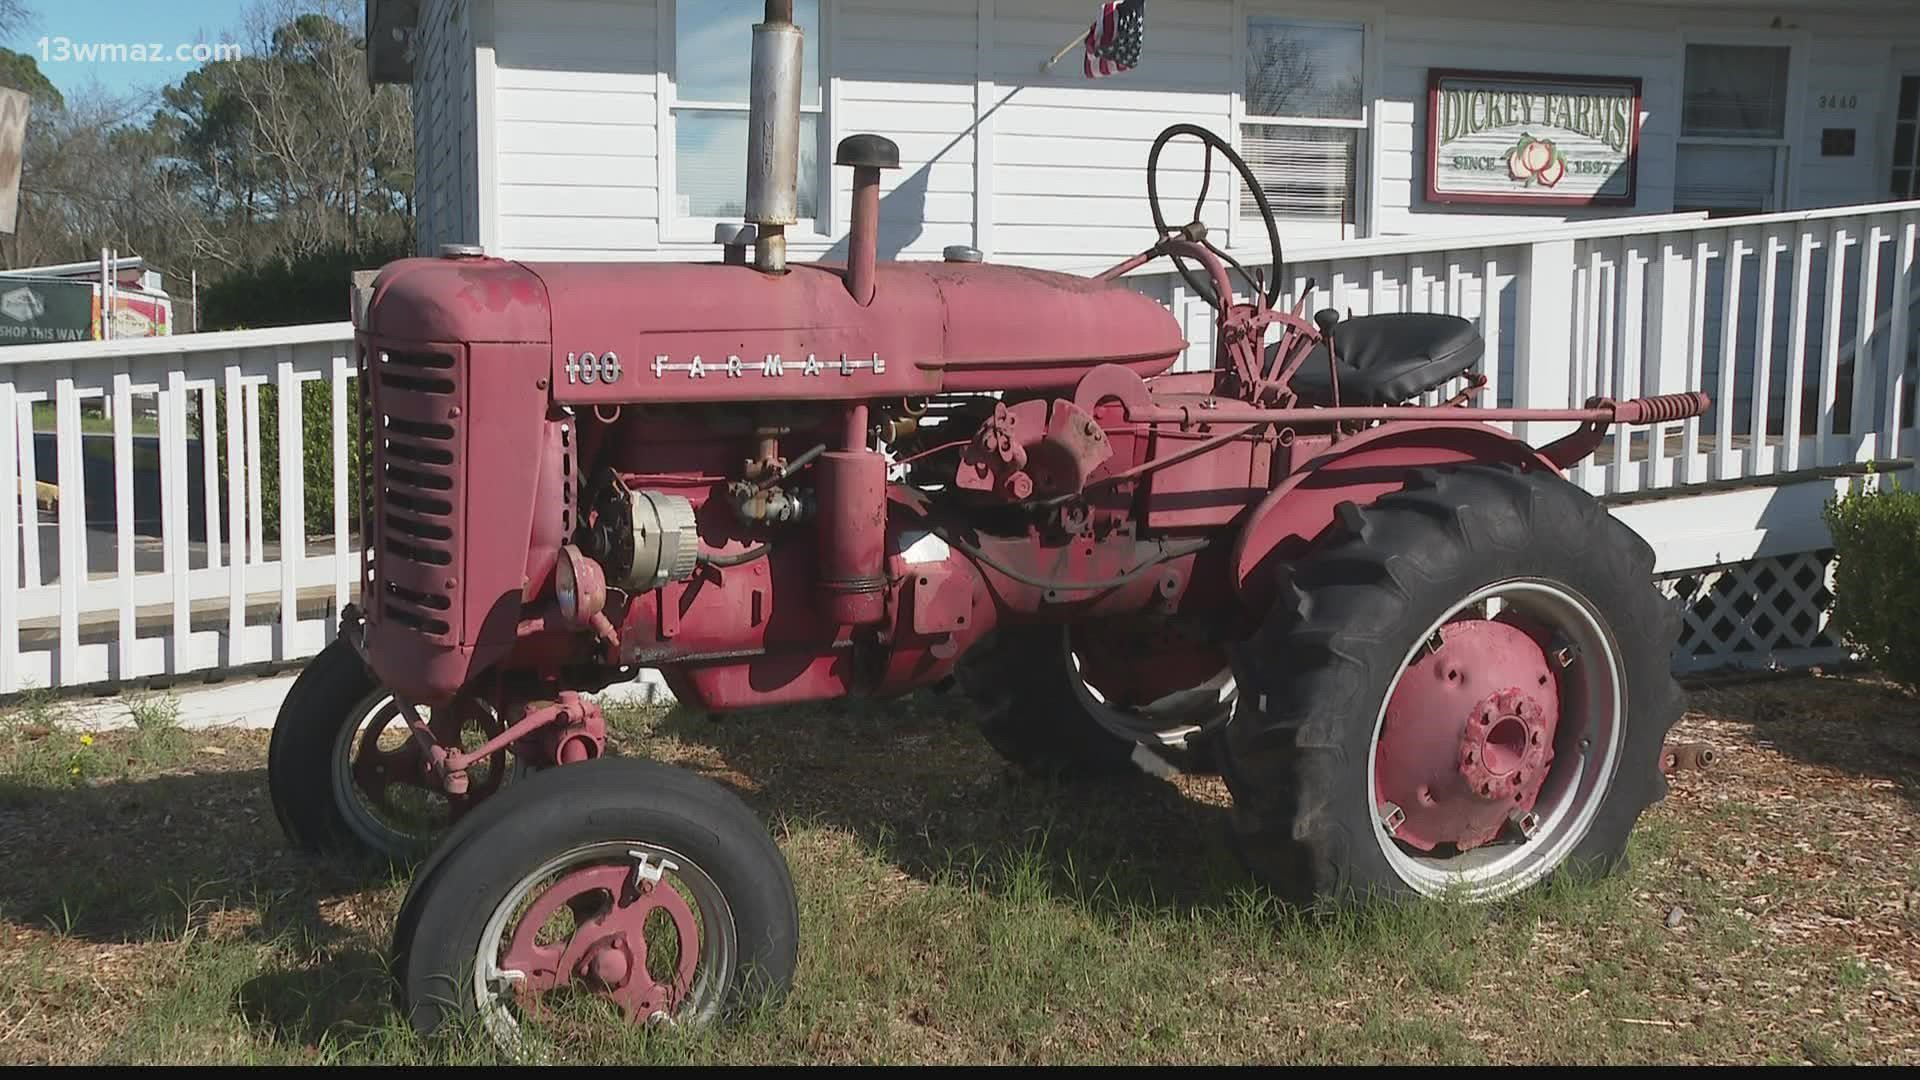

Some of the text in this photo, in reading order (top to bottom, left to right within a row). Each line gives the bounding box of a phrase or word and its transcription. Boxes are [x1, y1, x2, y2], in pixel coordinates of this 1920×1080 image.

[1819, 95, 1857, 109] 3440
[1440, 88, 1628, 152] DICKEY FARMS
[1453, 156, 1611, 175] SINCE 1897
[30, 327, 54, 339] THIS
[56, 328, 84, 341] WAY
[566, 351, 887, 384] 100 FARMALL
